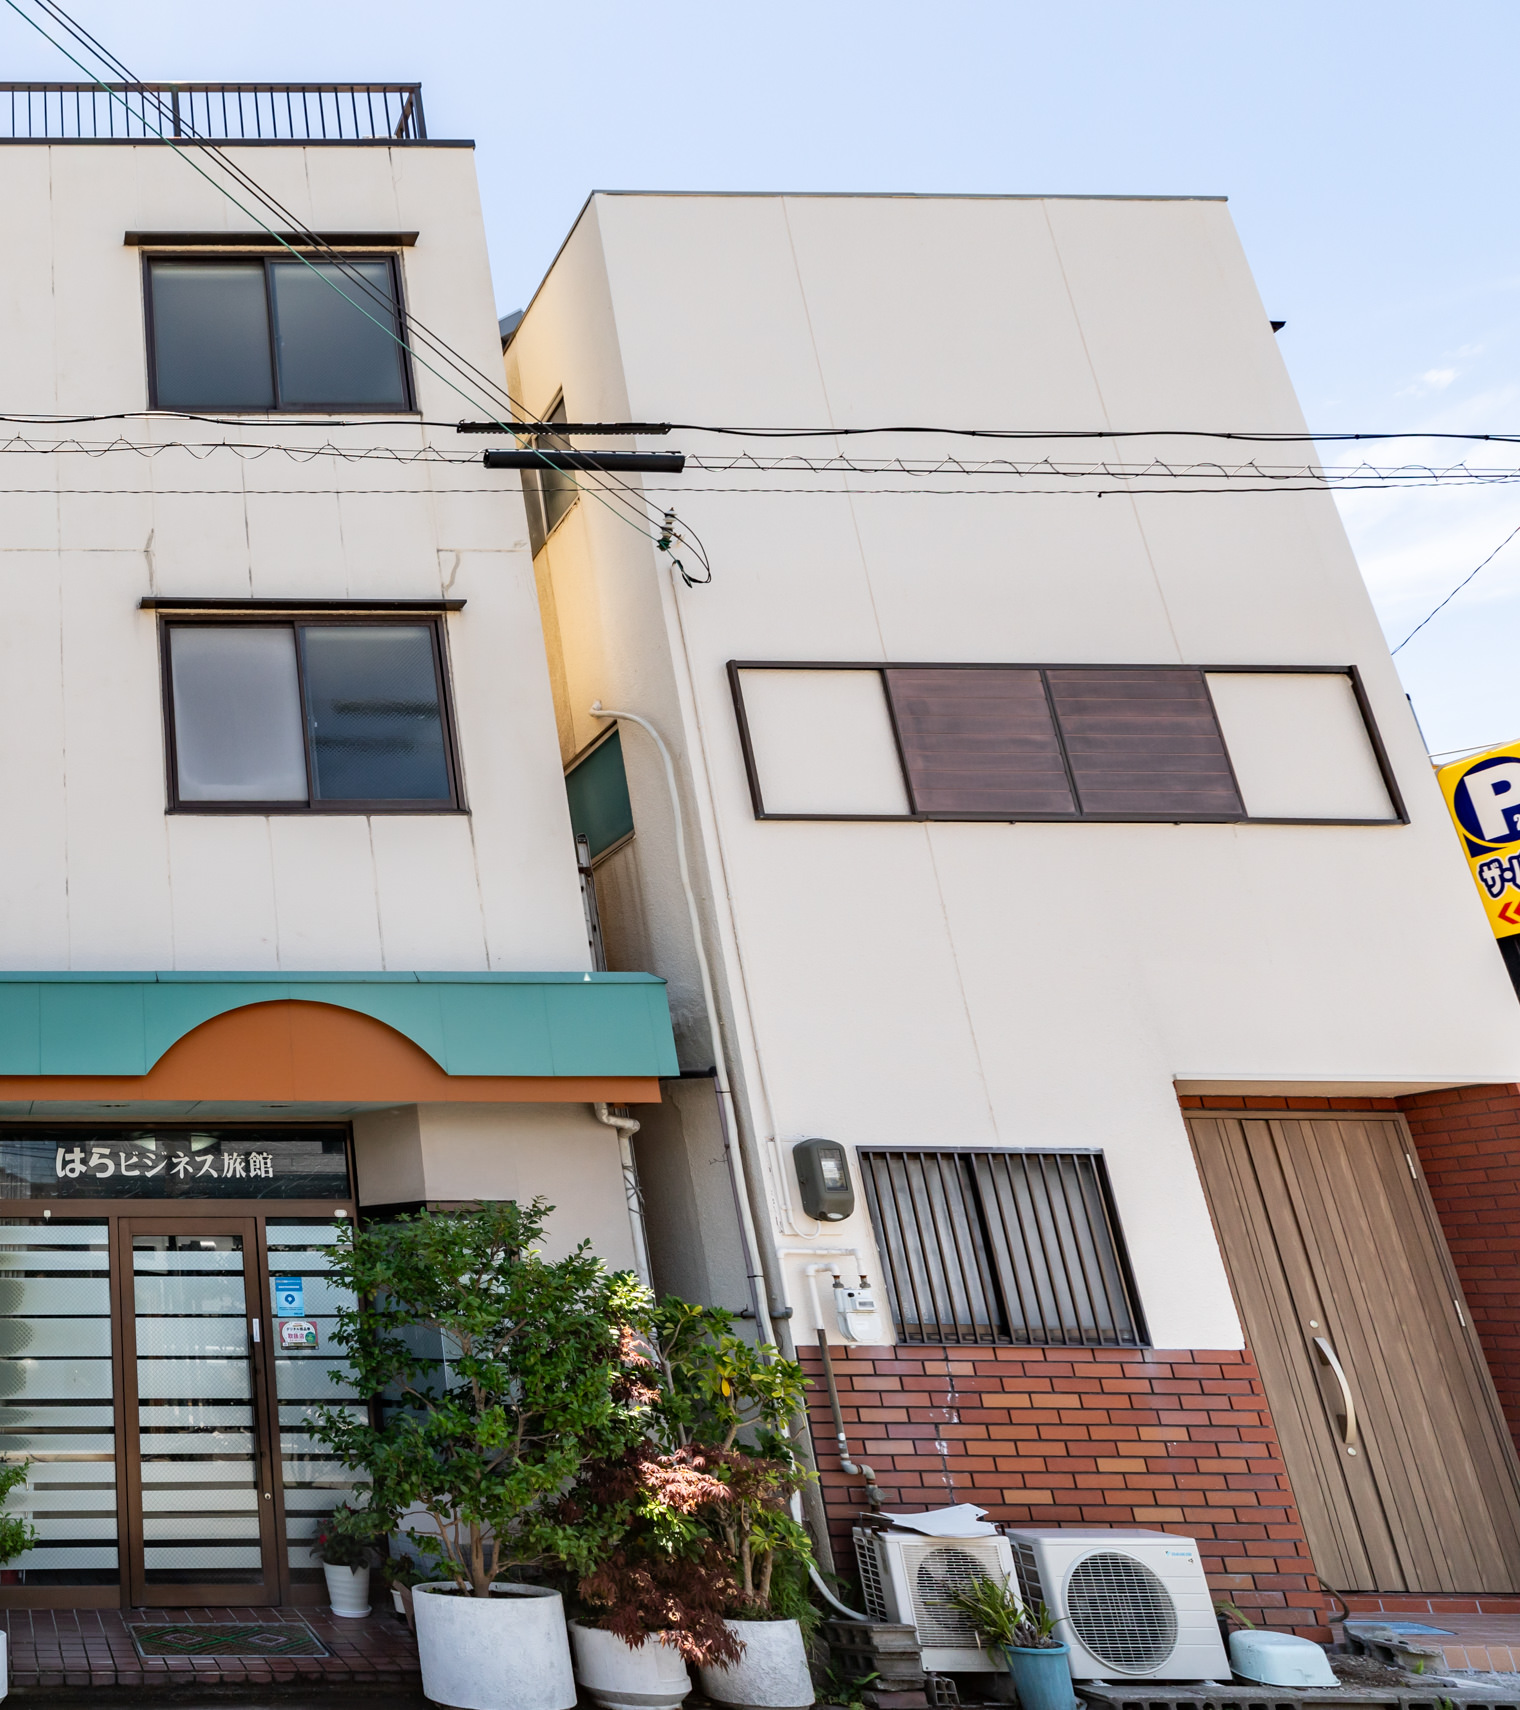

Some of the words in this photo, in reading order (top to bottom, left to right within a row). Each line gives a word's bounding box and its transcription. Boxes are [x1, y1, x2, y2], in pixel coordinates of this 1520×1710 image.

[1463, 762, 1520, 841] P
[55, 1147, 274, 1180] はらビジネス旅館
